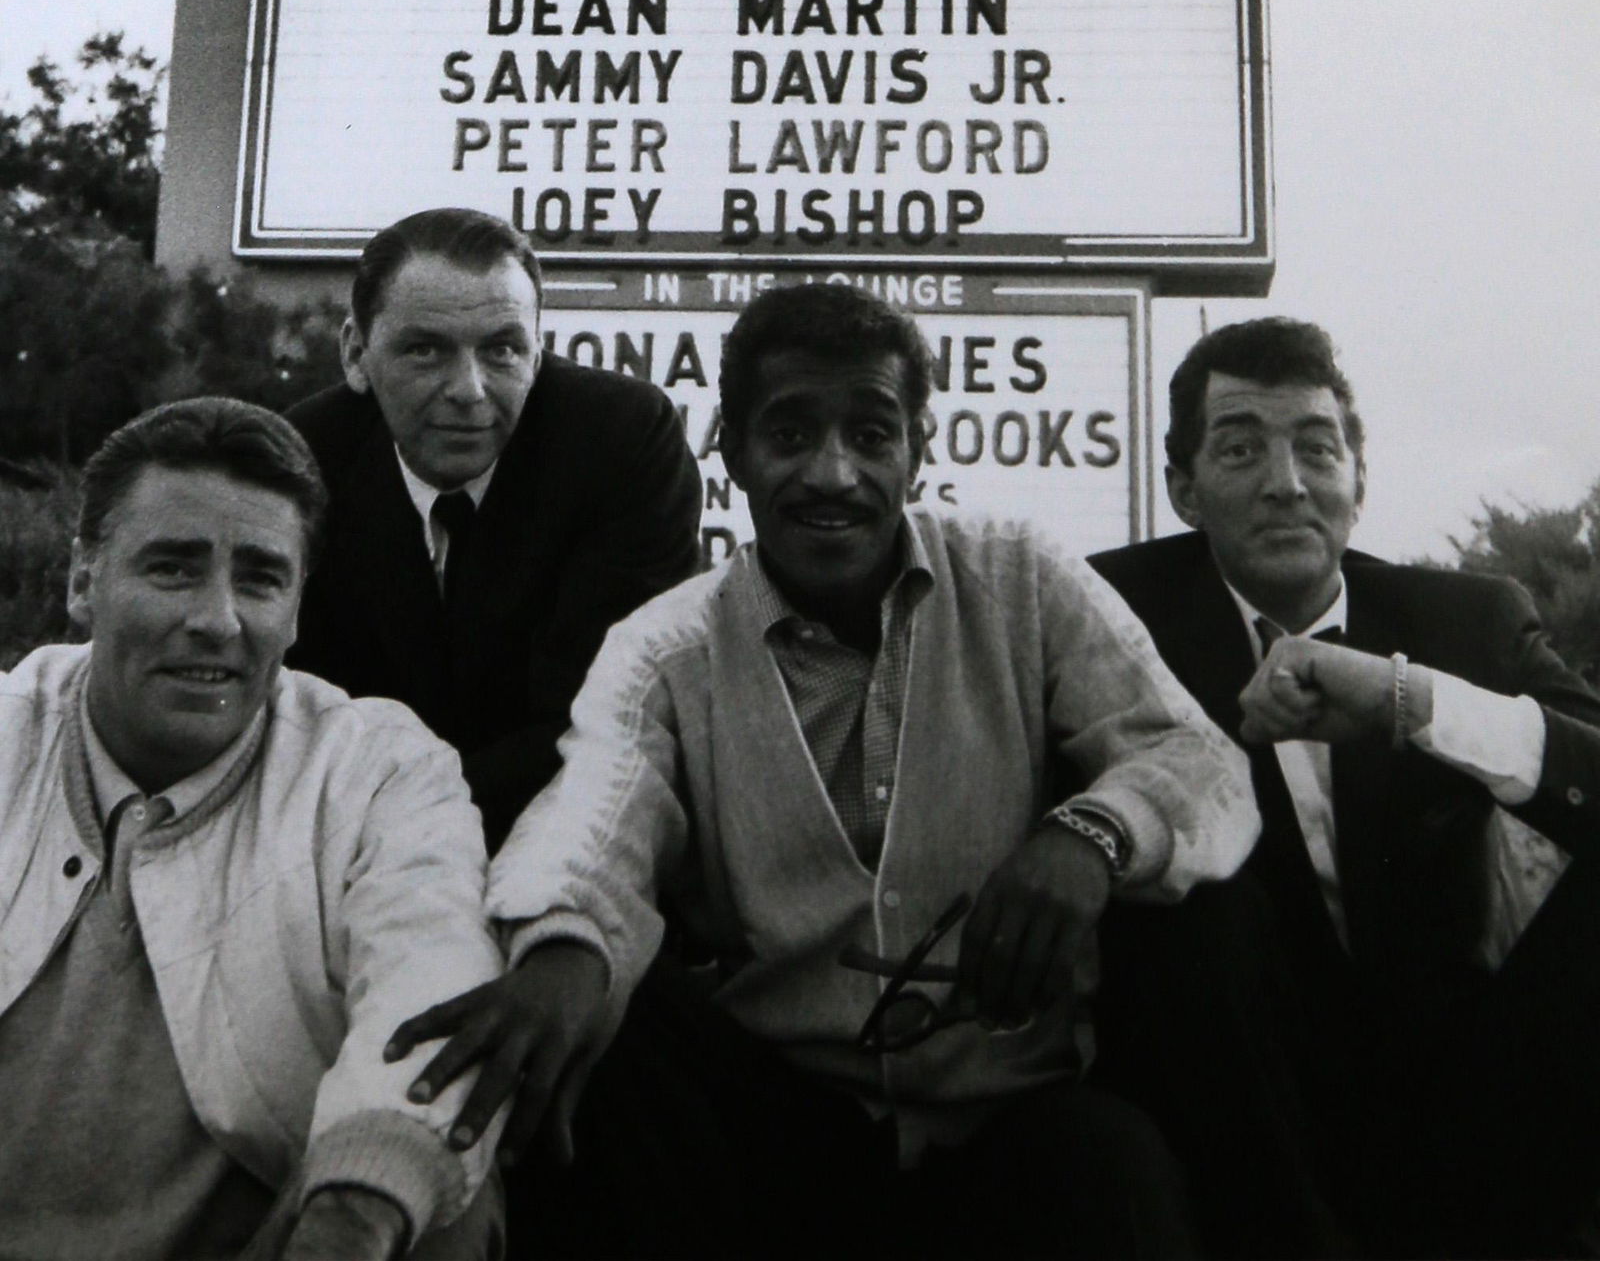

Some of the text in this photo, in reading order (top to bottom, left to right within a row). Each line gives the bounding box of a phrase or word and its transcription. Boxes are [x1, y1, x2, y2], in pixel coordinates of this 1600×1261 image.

[440, 49, 1065, 104] SAMMY DAVIS JR.
[452, 118, 1049, 174] PETER LAWFORD
[721, 188, 985, 246] BISHOP
[644, 273, 681, 304] IN
